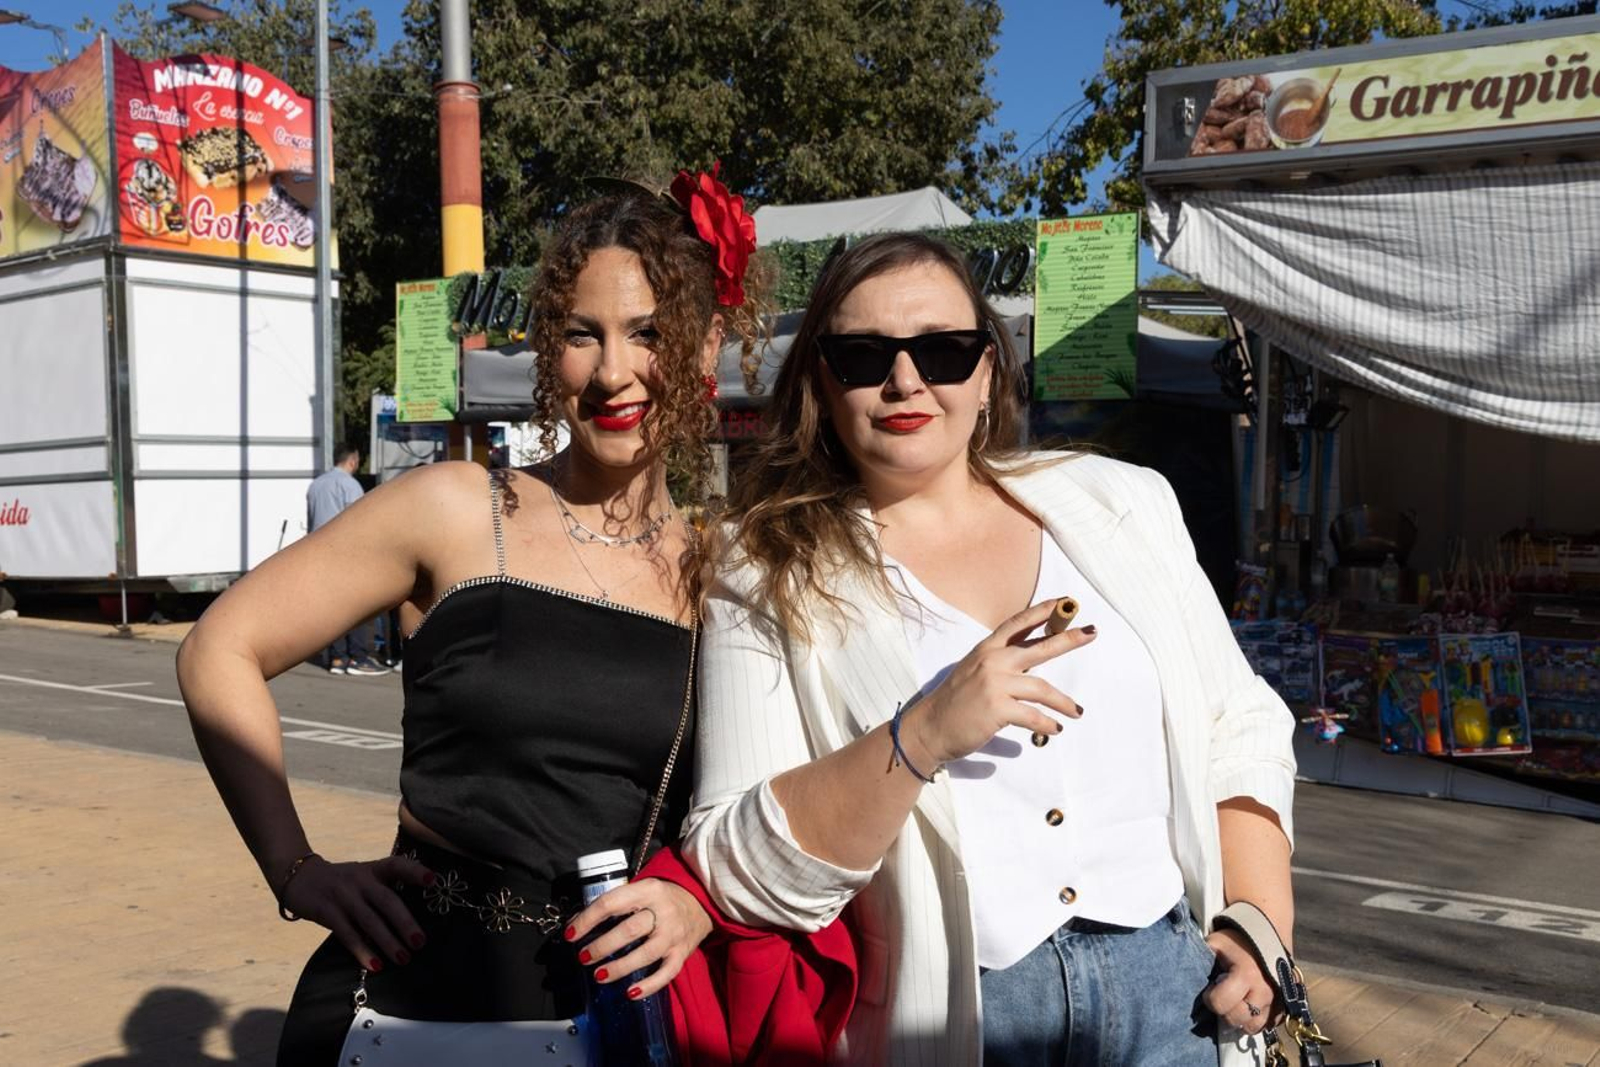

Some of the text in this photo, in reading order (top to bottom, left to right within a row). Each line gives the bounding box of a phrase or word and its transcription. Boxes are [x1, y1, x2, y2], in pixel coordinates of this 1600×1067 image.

[153, 62, 264, 98] MANZANO
[193, 91, 216, 122] La
[188, 194, 290, 248] Gofres
